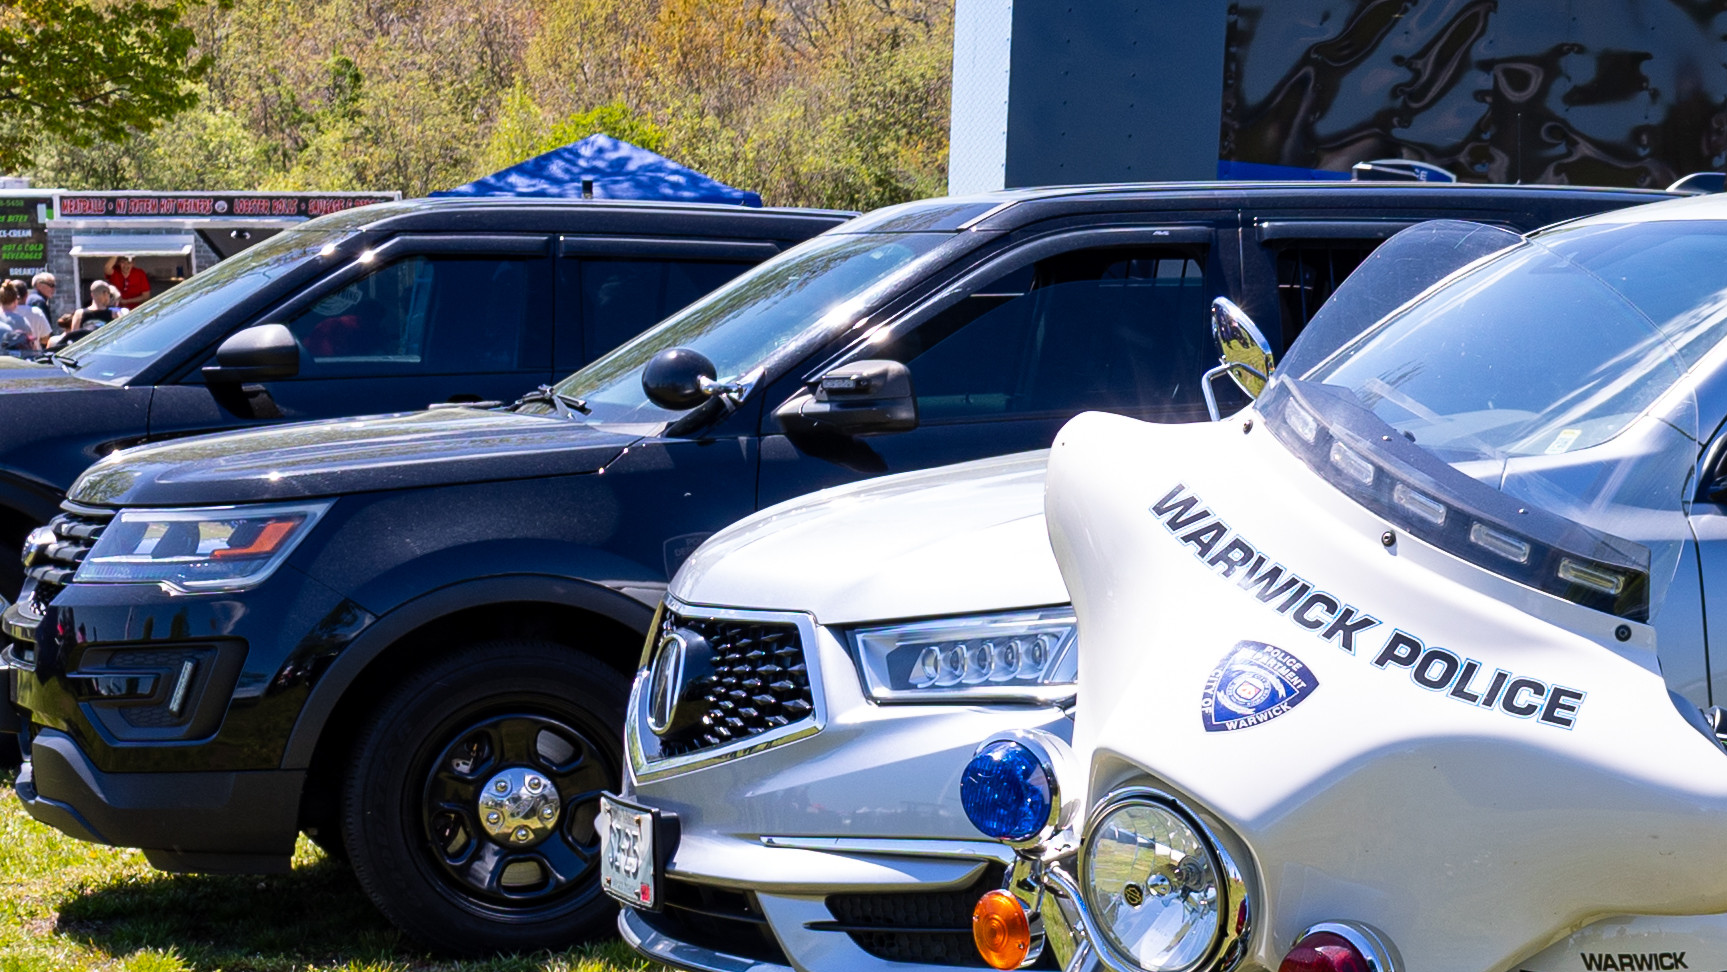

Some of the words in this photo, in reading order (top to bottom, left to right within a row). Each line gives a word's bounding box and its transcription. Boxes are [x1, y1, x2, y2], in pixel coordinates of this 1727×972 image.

[61, 198, 106, 214] MEATBALLS
[115, 198, 127, 214] NY
[128, 198, 158, 214] SYSTEM
[160, 198, 176, 214] HOT
[233, 198, 270, 215] LOBSTER
[272, 198, 298, 215] ROLLS
[1152, 482, 1379, 651] WARWICK
[1373, 632, 1584, 728] POLICE
[1264, 645, 1303, 672] POLICE
[1202, 697, 1212, 715] OF
[1225, 702, 1291, 731] WARWICK
[1580, 951, 1689, 972] WARWICK
